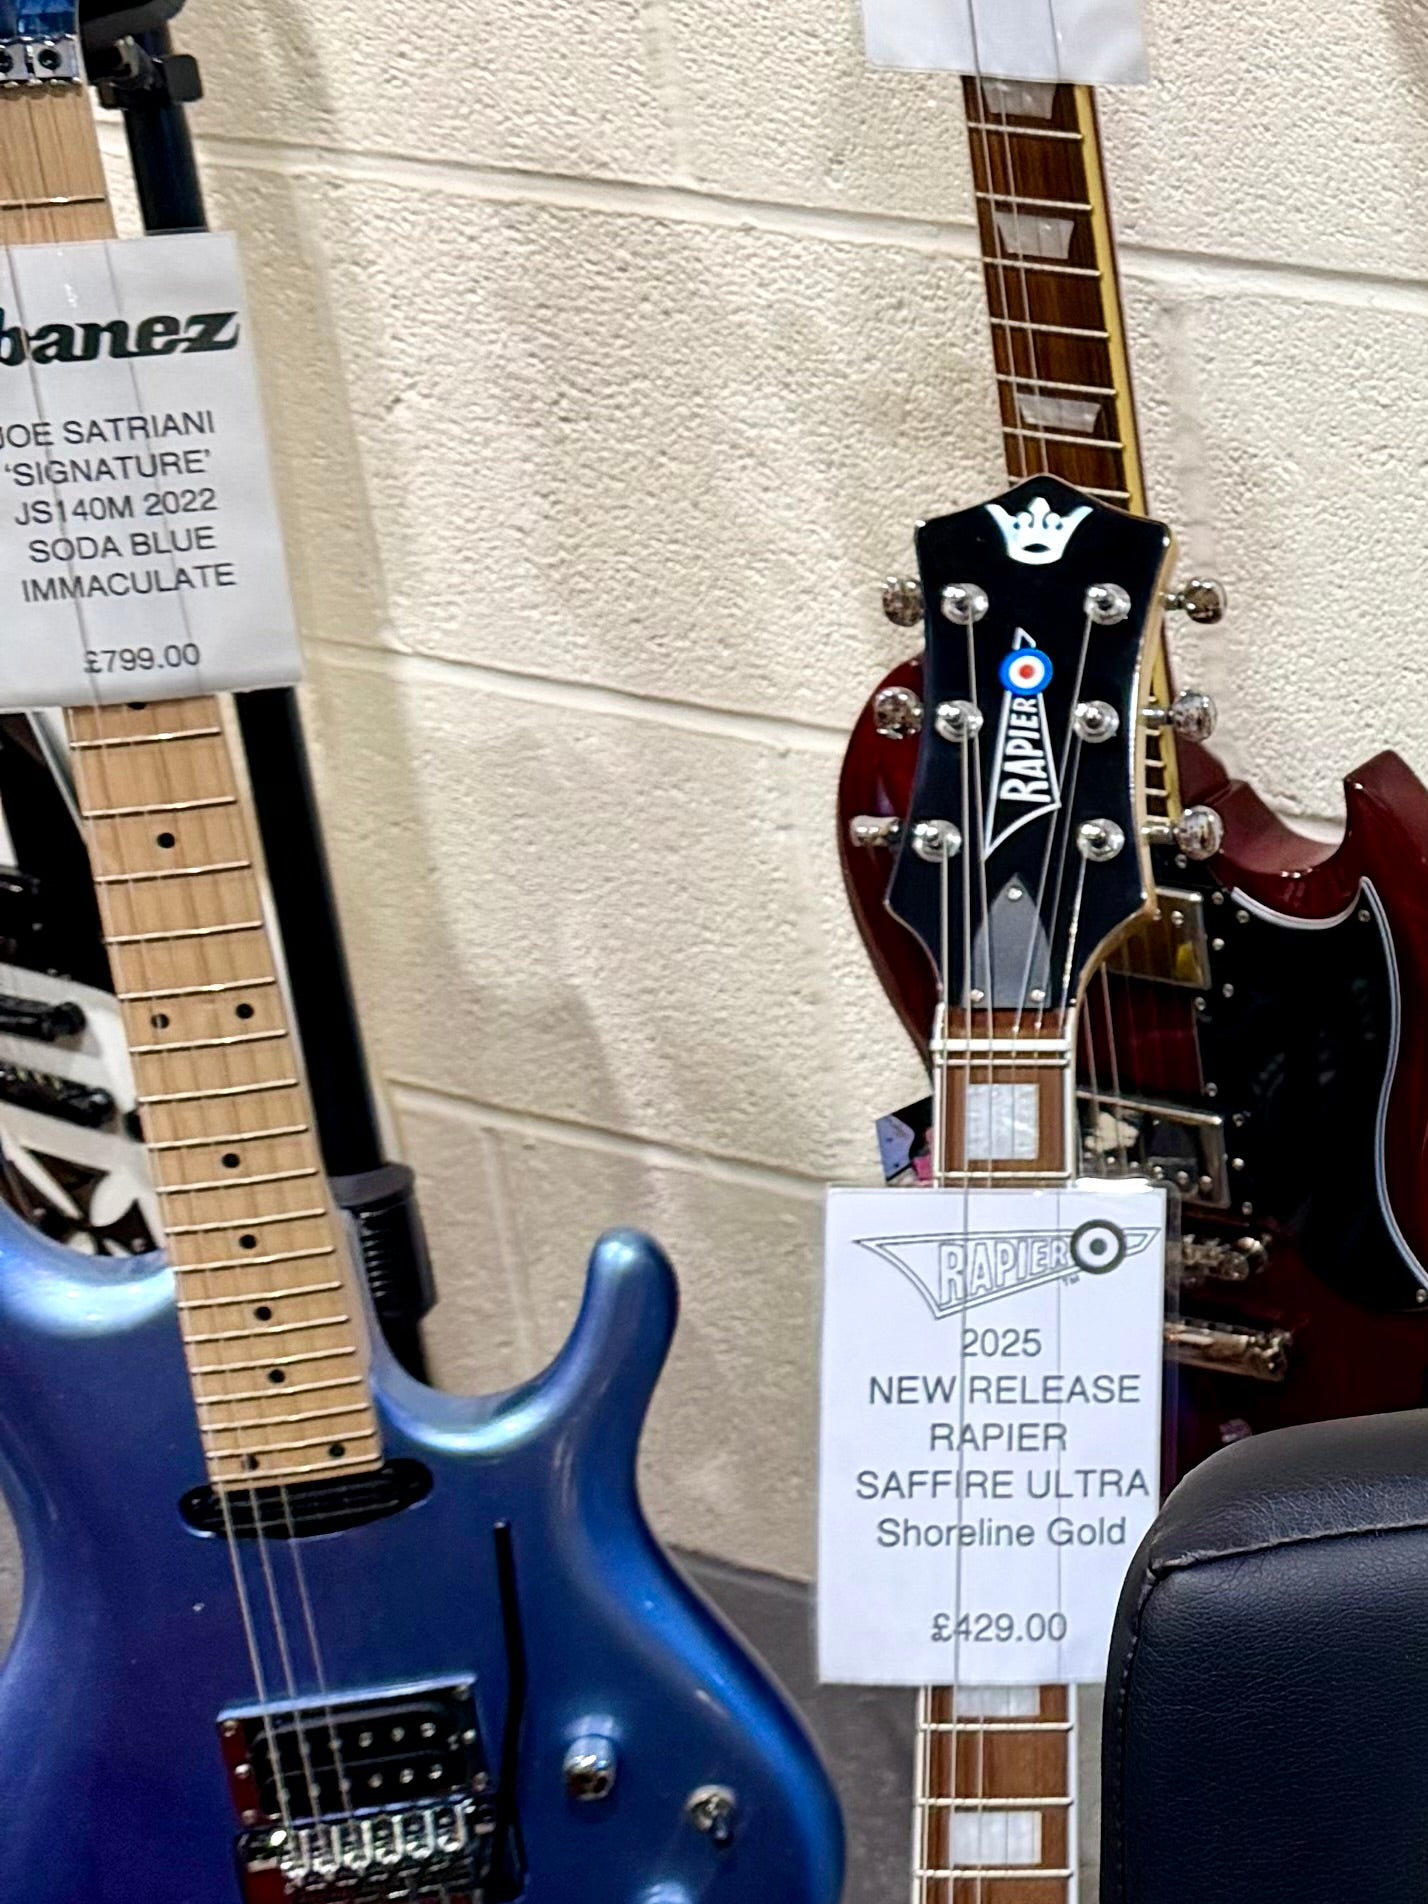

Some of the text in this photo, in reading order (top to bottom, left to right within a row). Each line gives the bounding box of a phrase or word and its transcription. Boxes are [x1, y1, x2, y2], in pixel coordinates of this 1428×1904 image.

[0, 307, 240, 366] banez
[63, 410, 214, 445] SATRIANI
[15, 488, 218, 526] JS140M 2022
[29, 527, 216, 563] SODA BLUE
[22, 563, 236, 602] IMMACULATE
[84, 643, 200, 673] £799.00
[1000, 698, 1051, 803] RAPIER
[938, 1238, 1070, 1306] RAPIER
[962, 1328, 1042, 1357] 2025
[869, 1375, 1141, 1405] NEW RELEASE
[930, 1423, 1068, 1451] RAPIER
[857, 1469, 1150, 1499] SAFFIRE ULTRA
[877, 1517, 1126, 1547] Shoreline Gold
[932, 1613, 1067, 1642] £429.00
